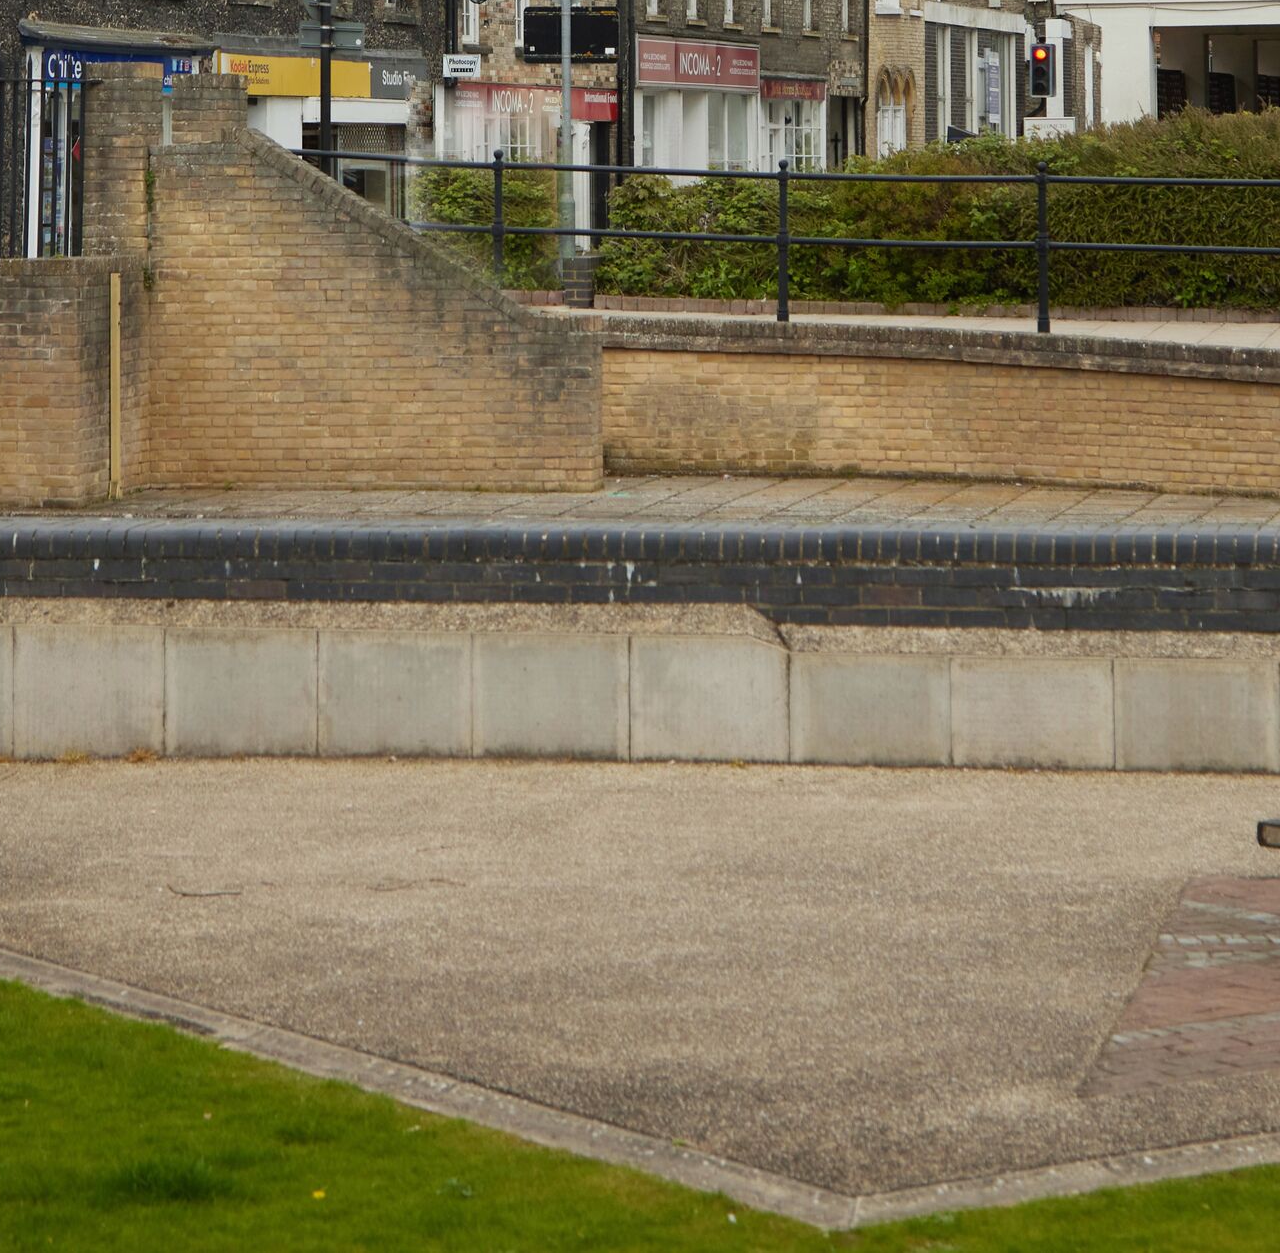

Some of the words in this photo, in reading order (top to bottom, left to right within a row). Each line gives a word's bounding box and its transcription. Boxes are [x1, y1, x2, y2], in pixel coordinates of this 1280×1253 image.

[229, 59, 248, 74] Kodak
[248, 59, 270, 76] Express
[448, 57, 477, 66] Photocopy
[679, 52, 711, 75] INCOMA
[716, 55, 721, 77] 2
[382, 69, 403, 86] Studio
[492, 90, 523, 113] INCOMA
[529, 91, 534, 114] 2
[584, 90, 607, 103] International
